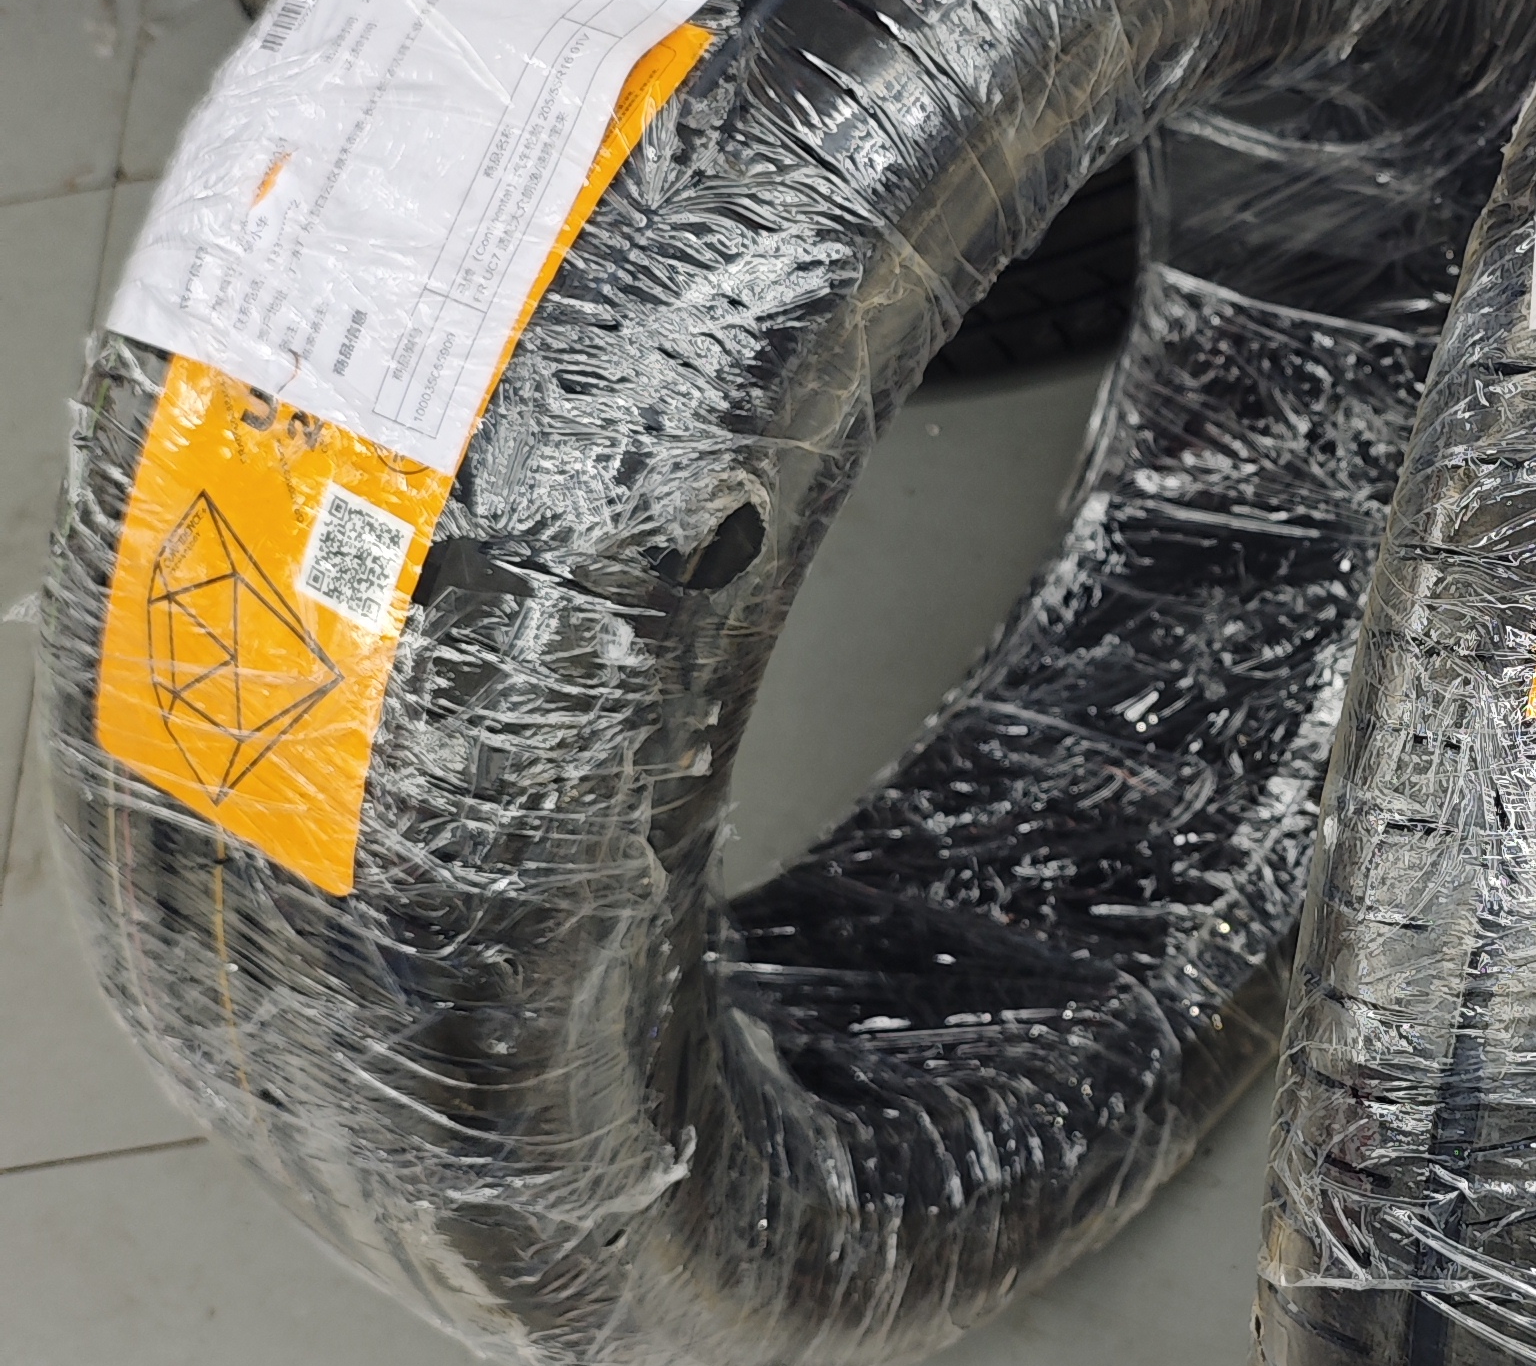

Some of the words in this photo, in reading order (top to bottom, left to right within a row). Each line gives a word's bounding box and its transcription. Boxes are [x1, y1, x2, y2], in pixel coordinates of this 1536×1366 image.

[482, 123, 516, 180] 商品名称
[472, 282, 488, 304] FR
[482, 252, 502, 281] UC7
[331, 307, 368, 377] 商品信息
